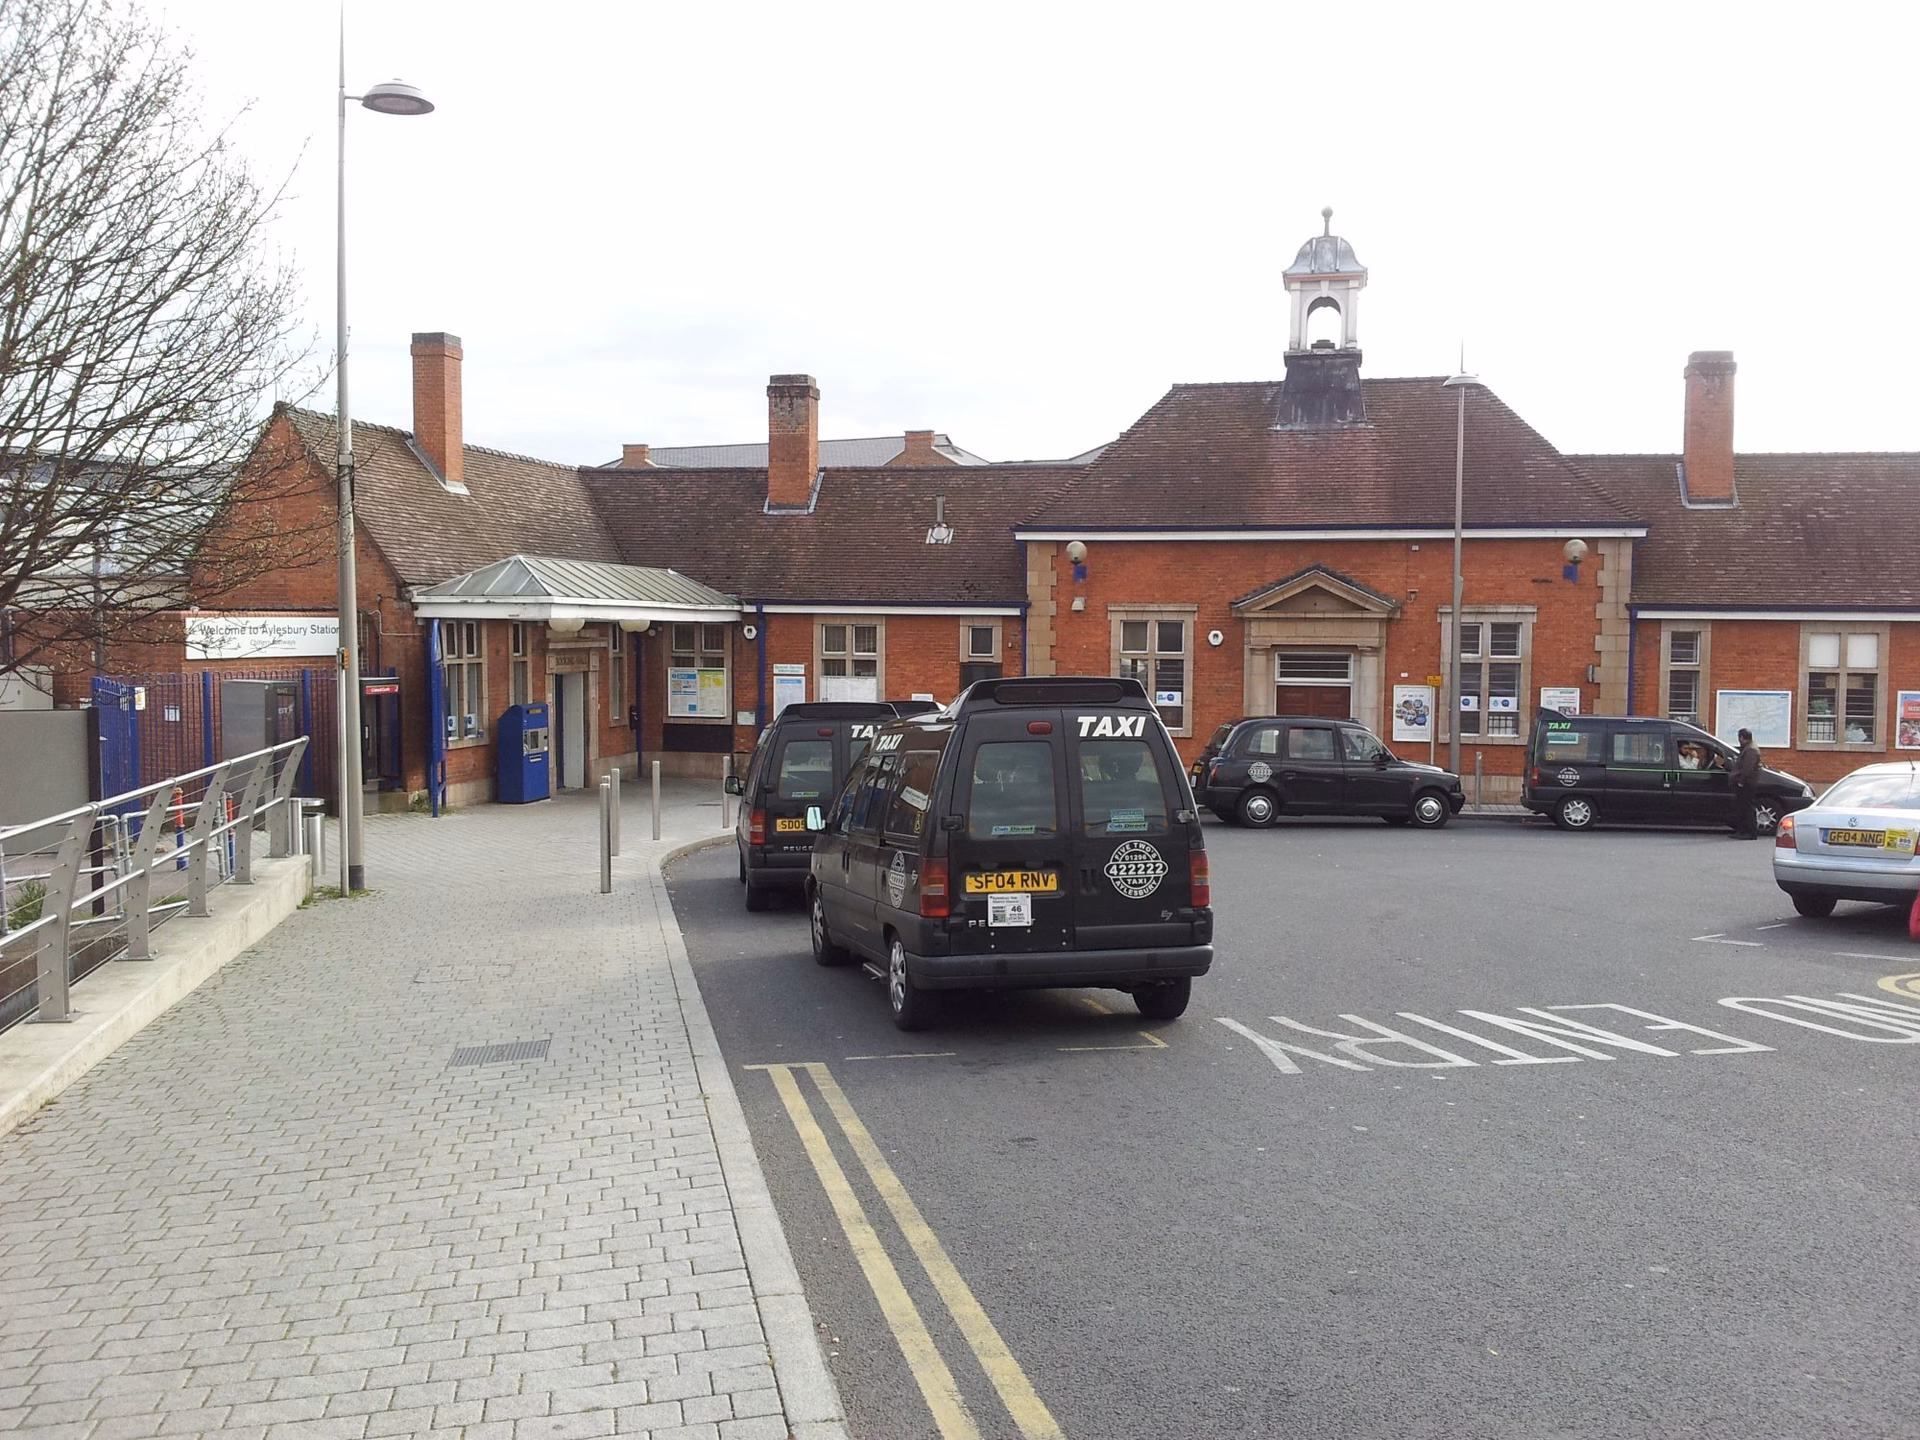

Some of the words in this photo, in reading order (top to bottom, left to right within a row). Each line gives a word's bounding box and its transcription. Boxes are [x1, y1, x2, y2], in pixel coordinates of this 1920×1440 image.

[200, 625, 246, 635] Welcome
[249, 625, 259, 635] to
[262, 625, 308, 636] Aylesbury
[1077, 716, 1146, 737] TAXI
[1548, 722, 1571, 730] TAXI
[876, 733, 904, 751] TAXI
[1830, 831, 1857, 842] GF04
[1860, 833, 1883, 844] NNG
[1114, 843, 1131, 860] FIVE
[1133, 843, 1157, 859] TWO'S
[1109, 862, 1164, 876] 422222
[974, 874, 1016, 889] SF04
[1020, 873, 1051, 888] RNV
[1115, 880, 1157, 896] AYLESBURY
[1213, 1003, 1778, 1074] ENTRY
